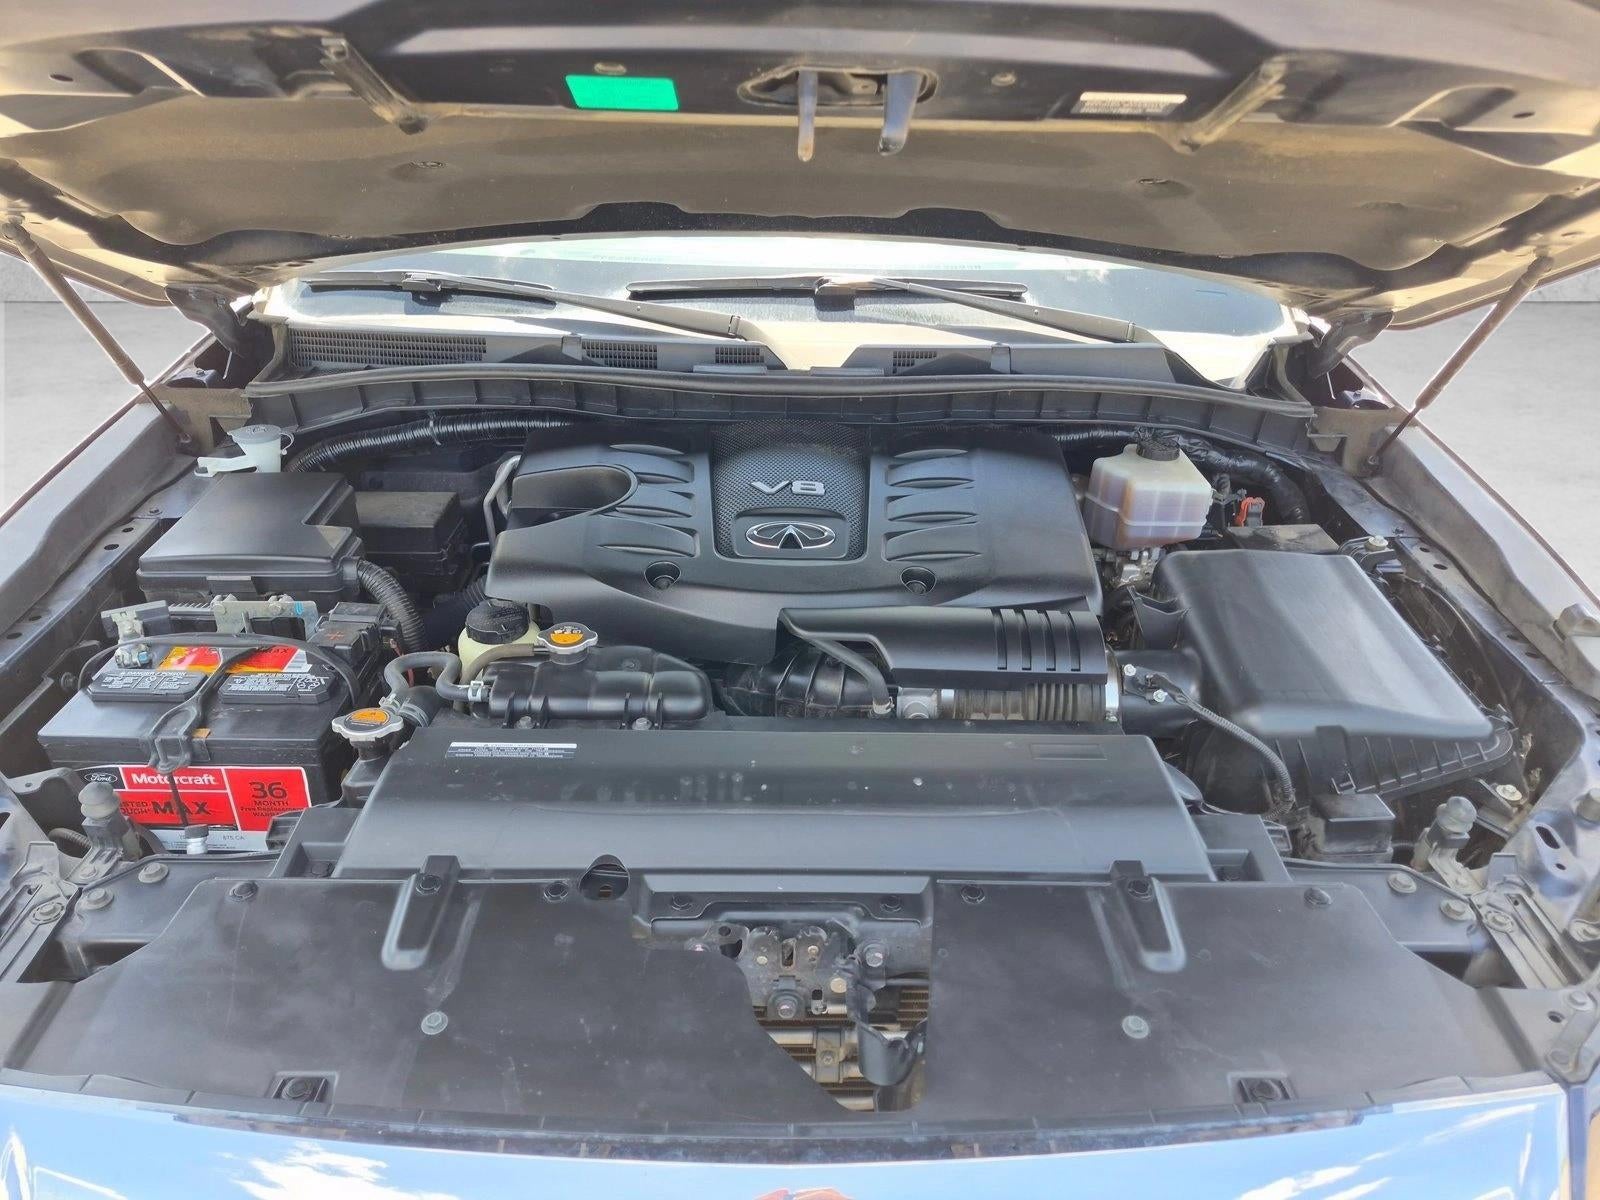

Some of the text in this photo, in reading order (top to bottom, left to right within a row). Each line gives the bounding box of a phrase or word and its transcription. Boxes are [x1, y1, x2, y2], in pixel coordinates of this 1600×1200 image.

[750, 480, 826, 496] V8
[90, 773, 112, 782] Ford
[131, 773, 216, 785] Motorcraft
[249, 782, 287, 799] 36
